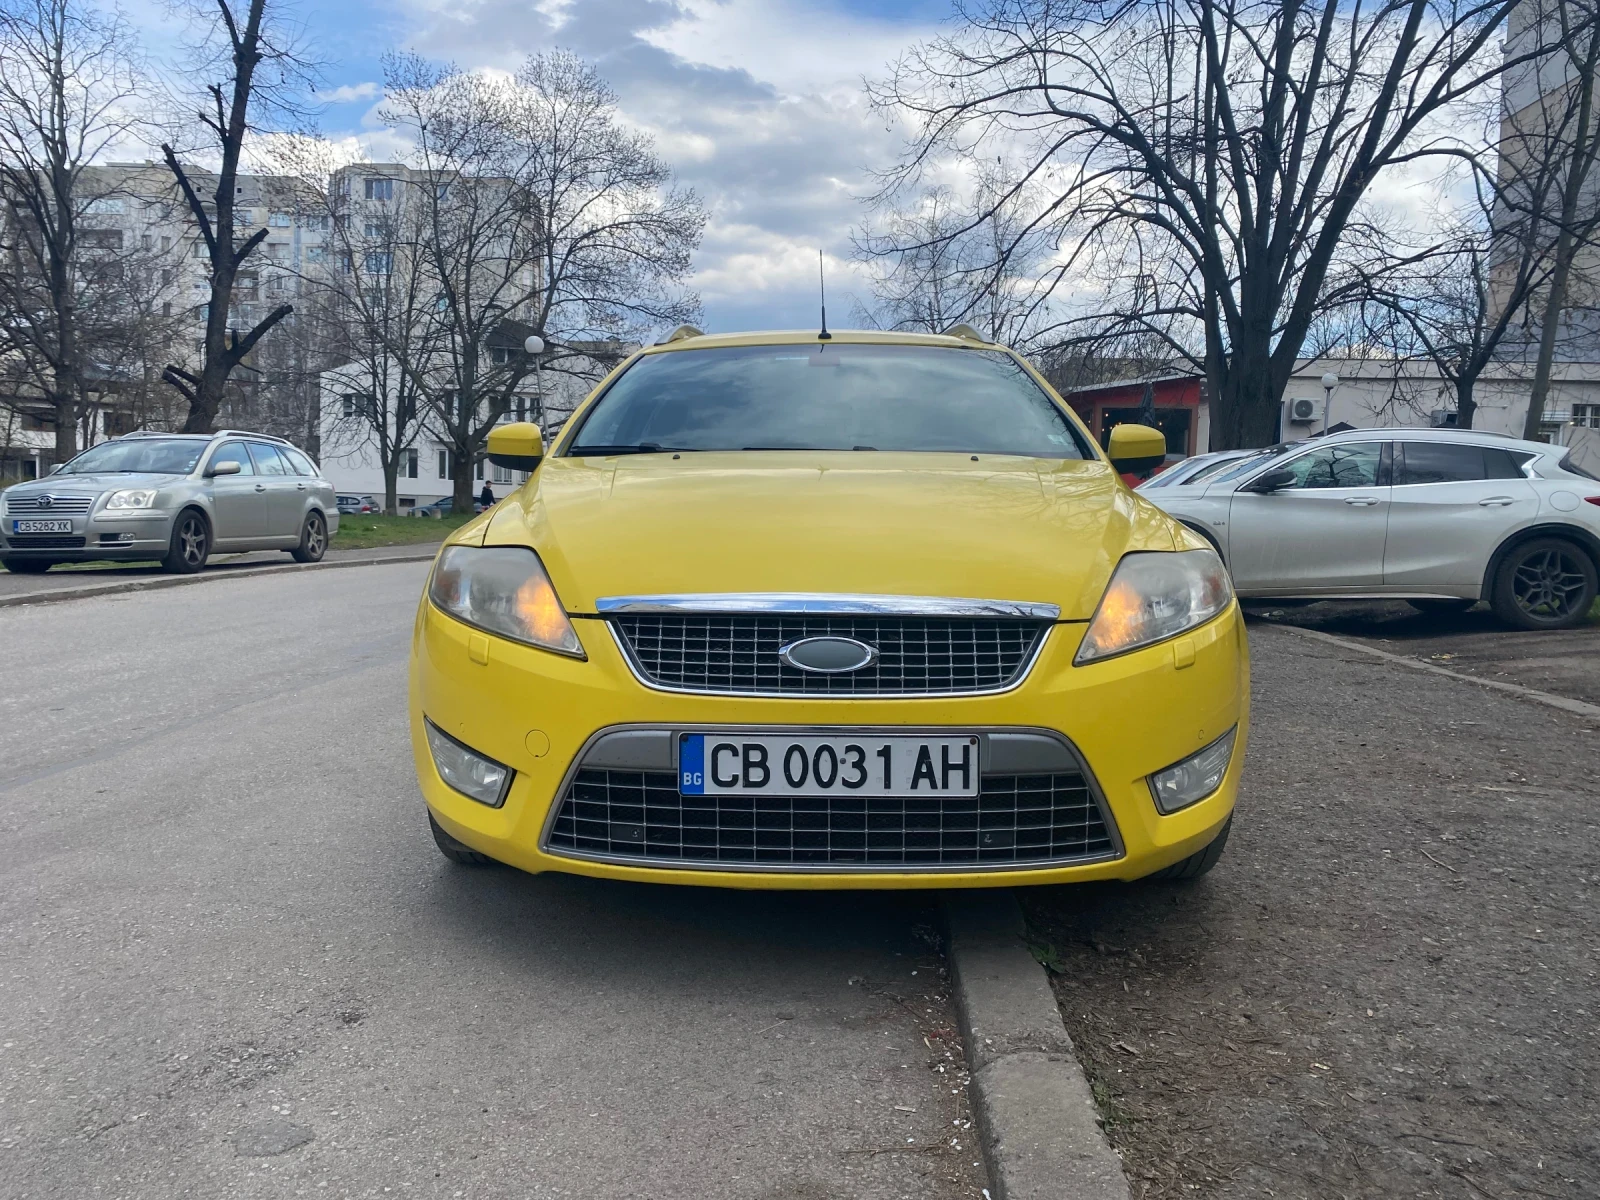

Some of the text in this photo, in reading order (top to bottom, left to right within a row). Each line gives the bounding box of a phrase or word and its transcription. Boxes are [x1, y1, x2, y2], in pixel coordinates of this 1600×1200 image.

[20, 521, 69, 531] CB 5282 XK
[711, 743, 970, 789] CB 0031 AH
[683, 772, 702, 786] BG
